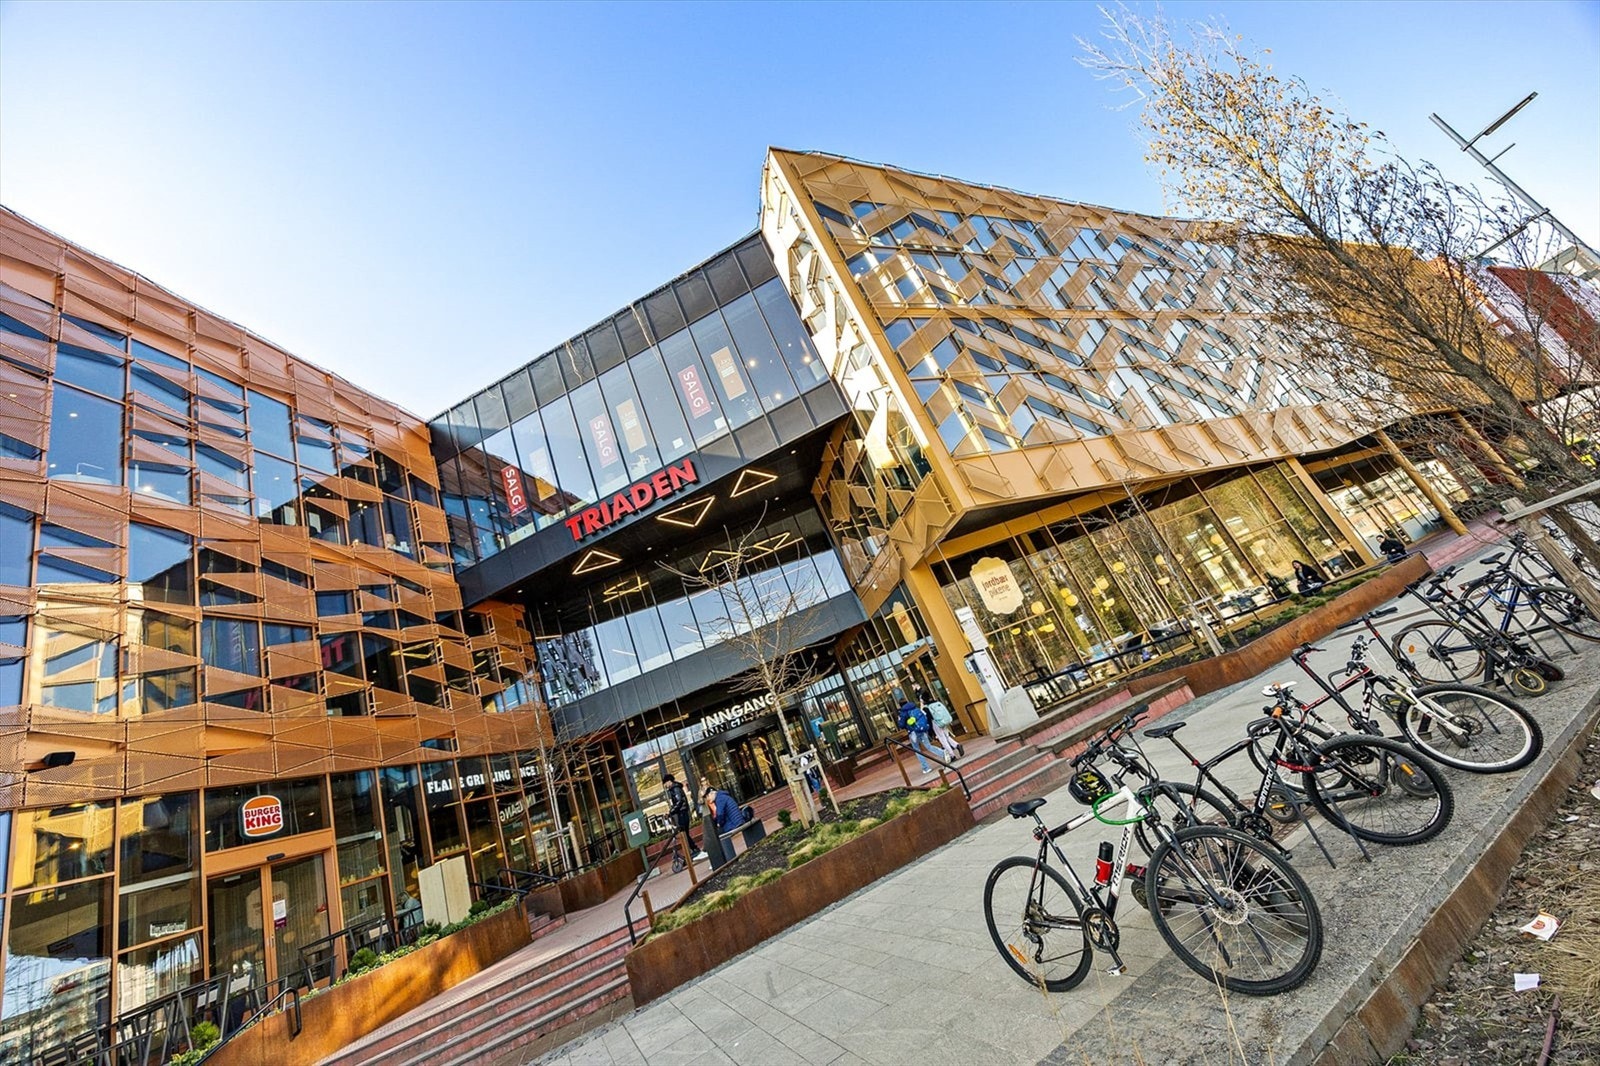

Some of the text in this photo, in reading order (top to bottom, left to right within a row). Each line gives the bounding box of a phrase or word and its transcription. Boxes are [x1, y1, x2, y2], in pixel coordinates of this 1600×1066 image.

[682, 370, 704, 408] SALG
[594, 419, 612, 457] SALG
[505, 468, 522, 506] SALG
[564, 458, 699, 542] TRIADEN
[700, 692, 775, 730] INNGANG
[244, 805, 281, 819] BURGER
[245, 813, 282, 830] KING
